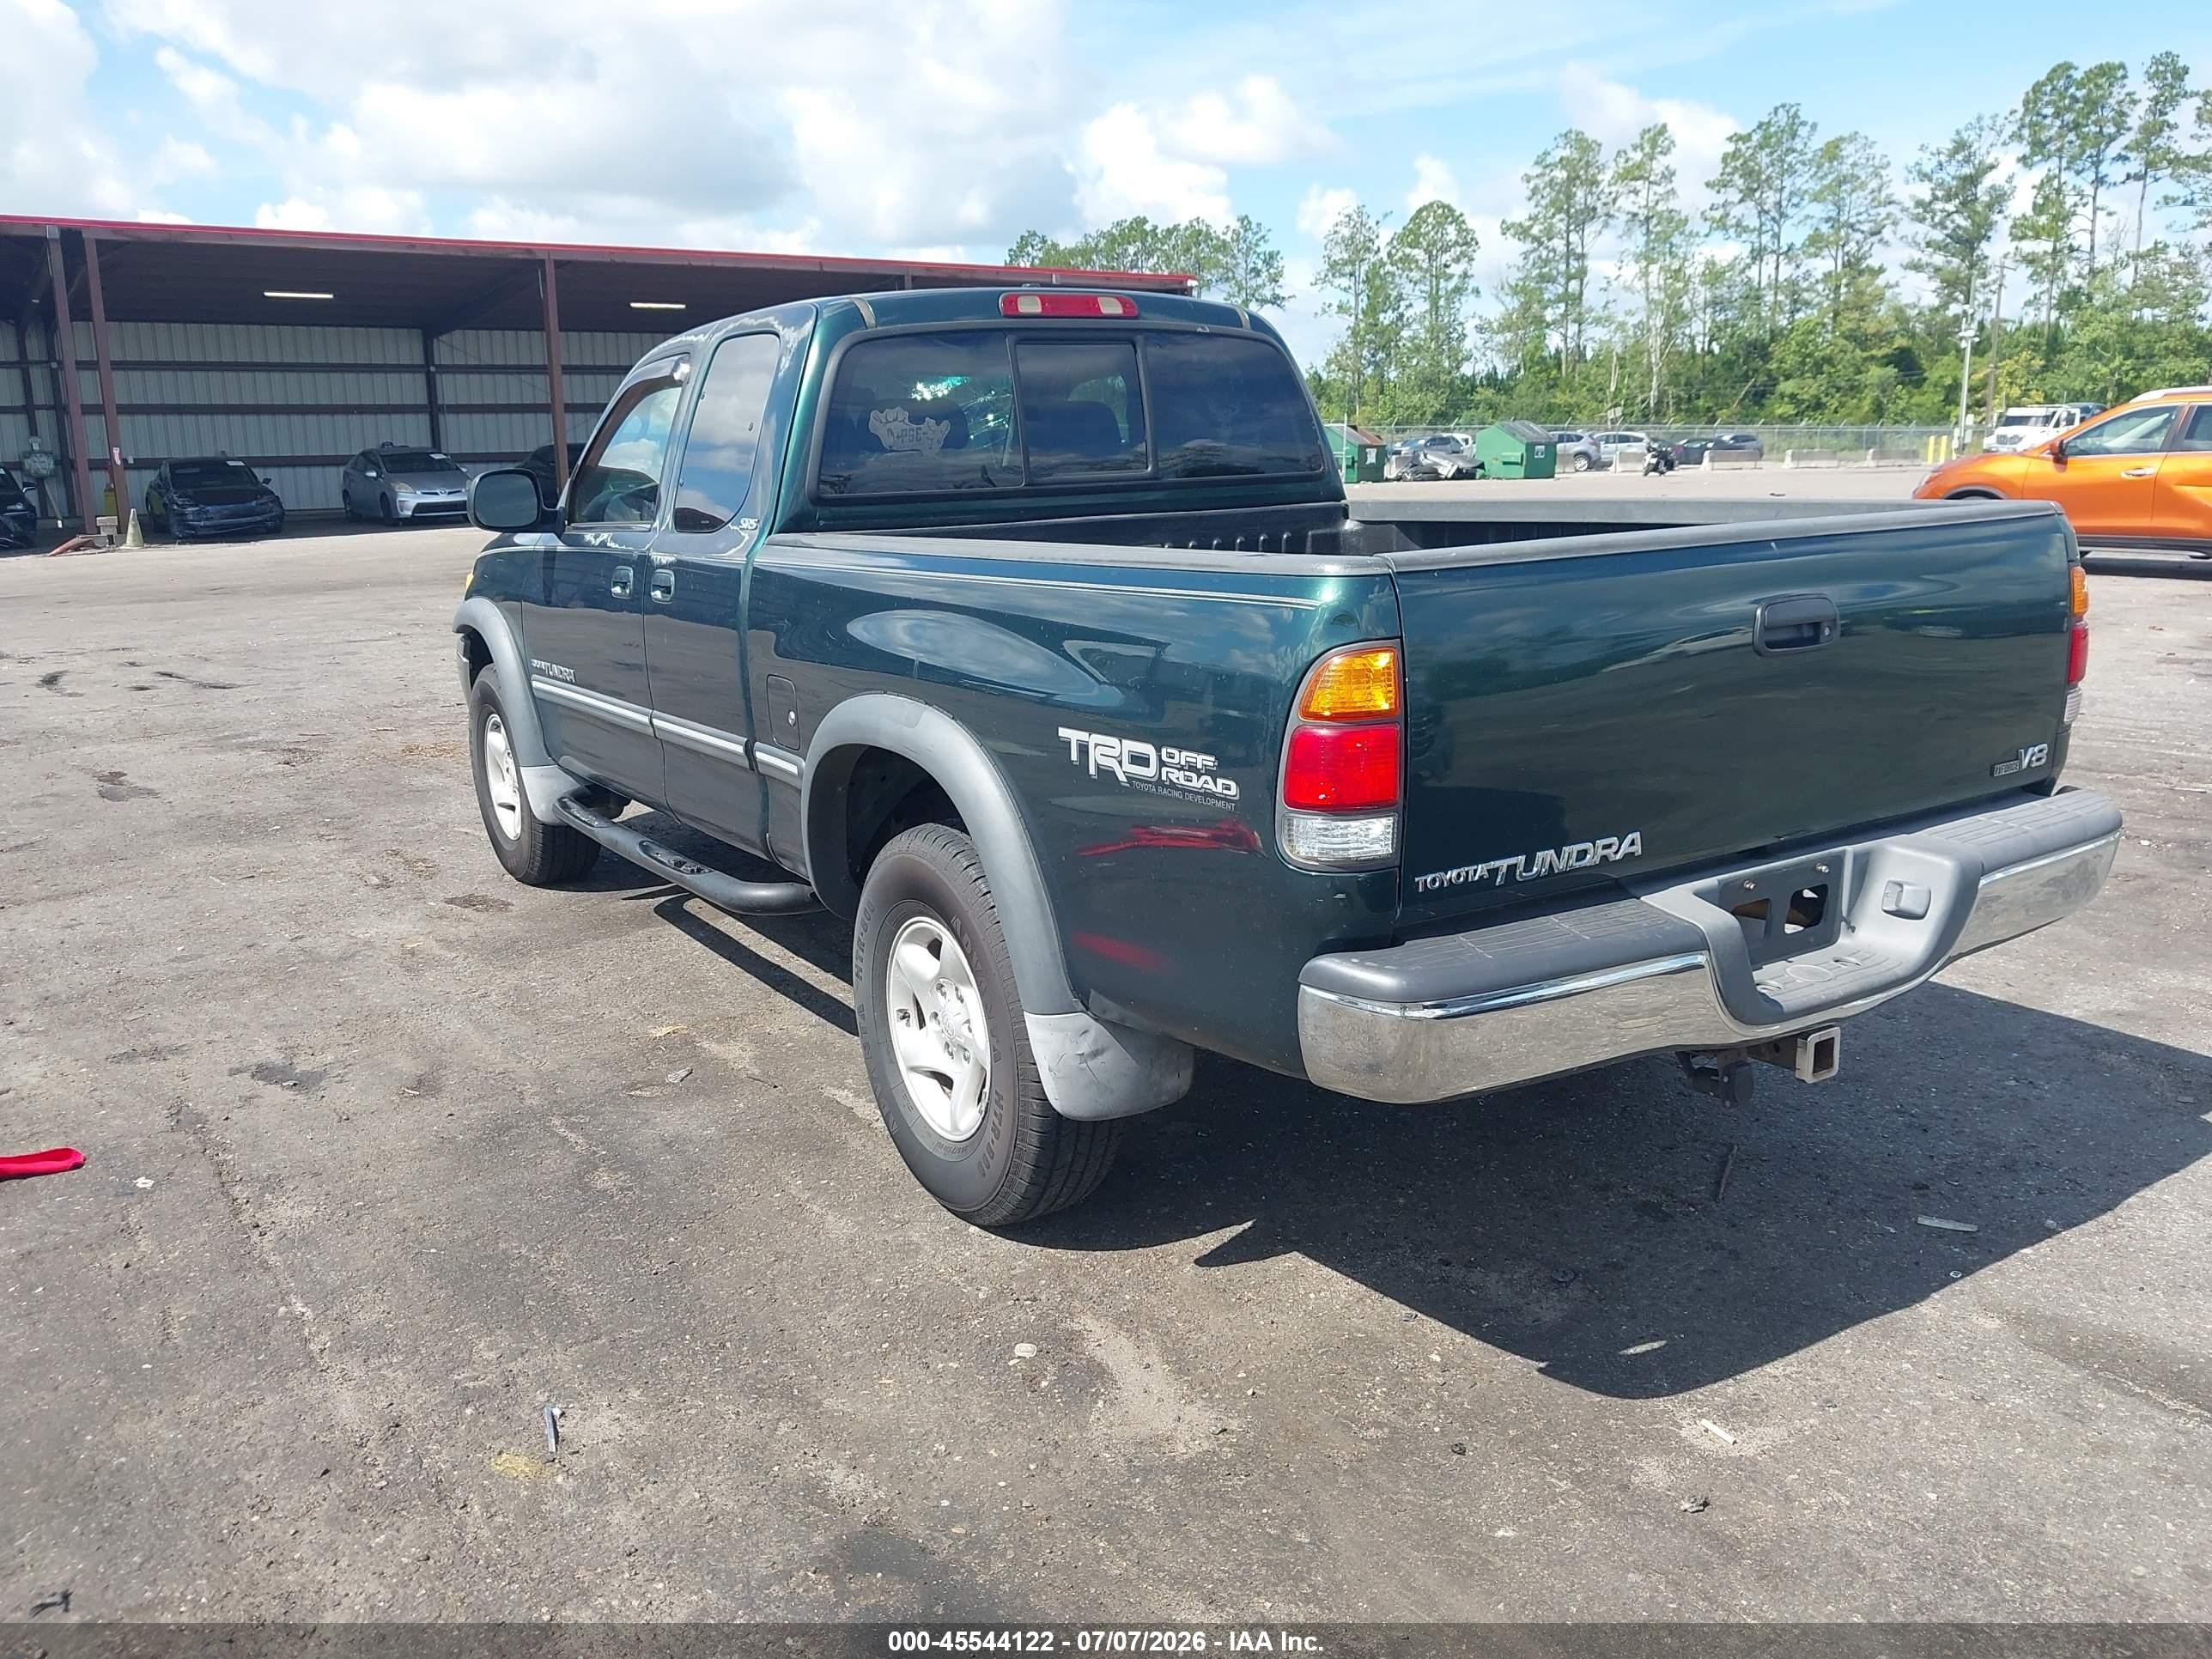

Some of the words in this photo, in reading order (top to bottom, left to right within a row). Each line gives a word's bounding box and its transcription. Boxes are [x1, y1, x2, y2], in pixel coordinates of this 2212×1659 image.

[1058, 726, 1158, 786] TRD
[1161, 746, 1218, 771] OFF
[2018, 743, 2048, 769] V8
[1132, 781, 1157, 793] TOYOTA
[1158, 786, 1183, 799] RACING
[1184, 793, 1236, 812] DEVELOPMENT
[1161, 766, 1239, 799] ROAD
[1415, 864, 1489, 893] TOYOTA
[1486, 831, 1642, 886] TUNDRA
